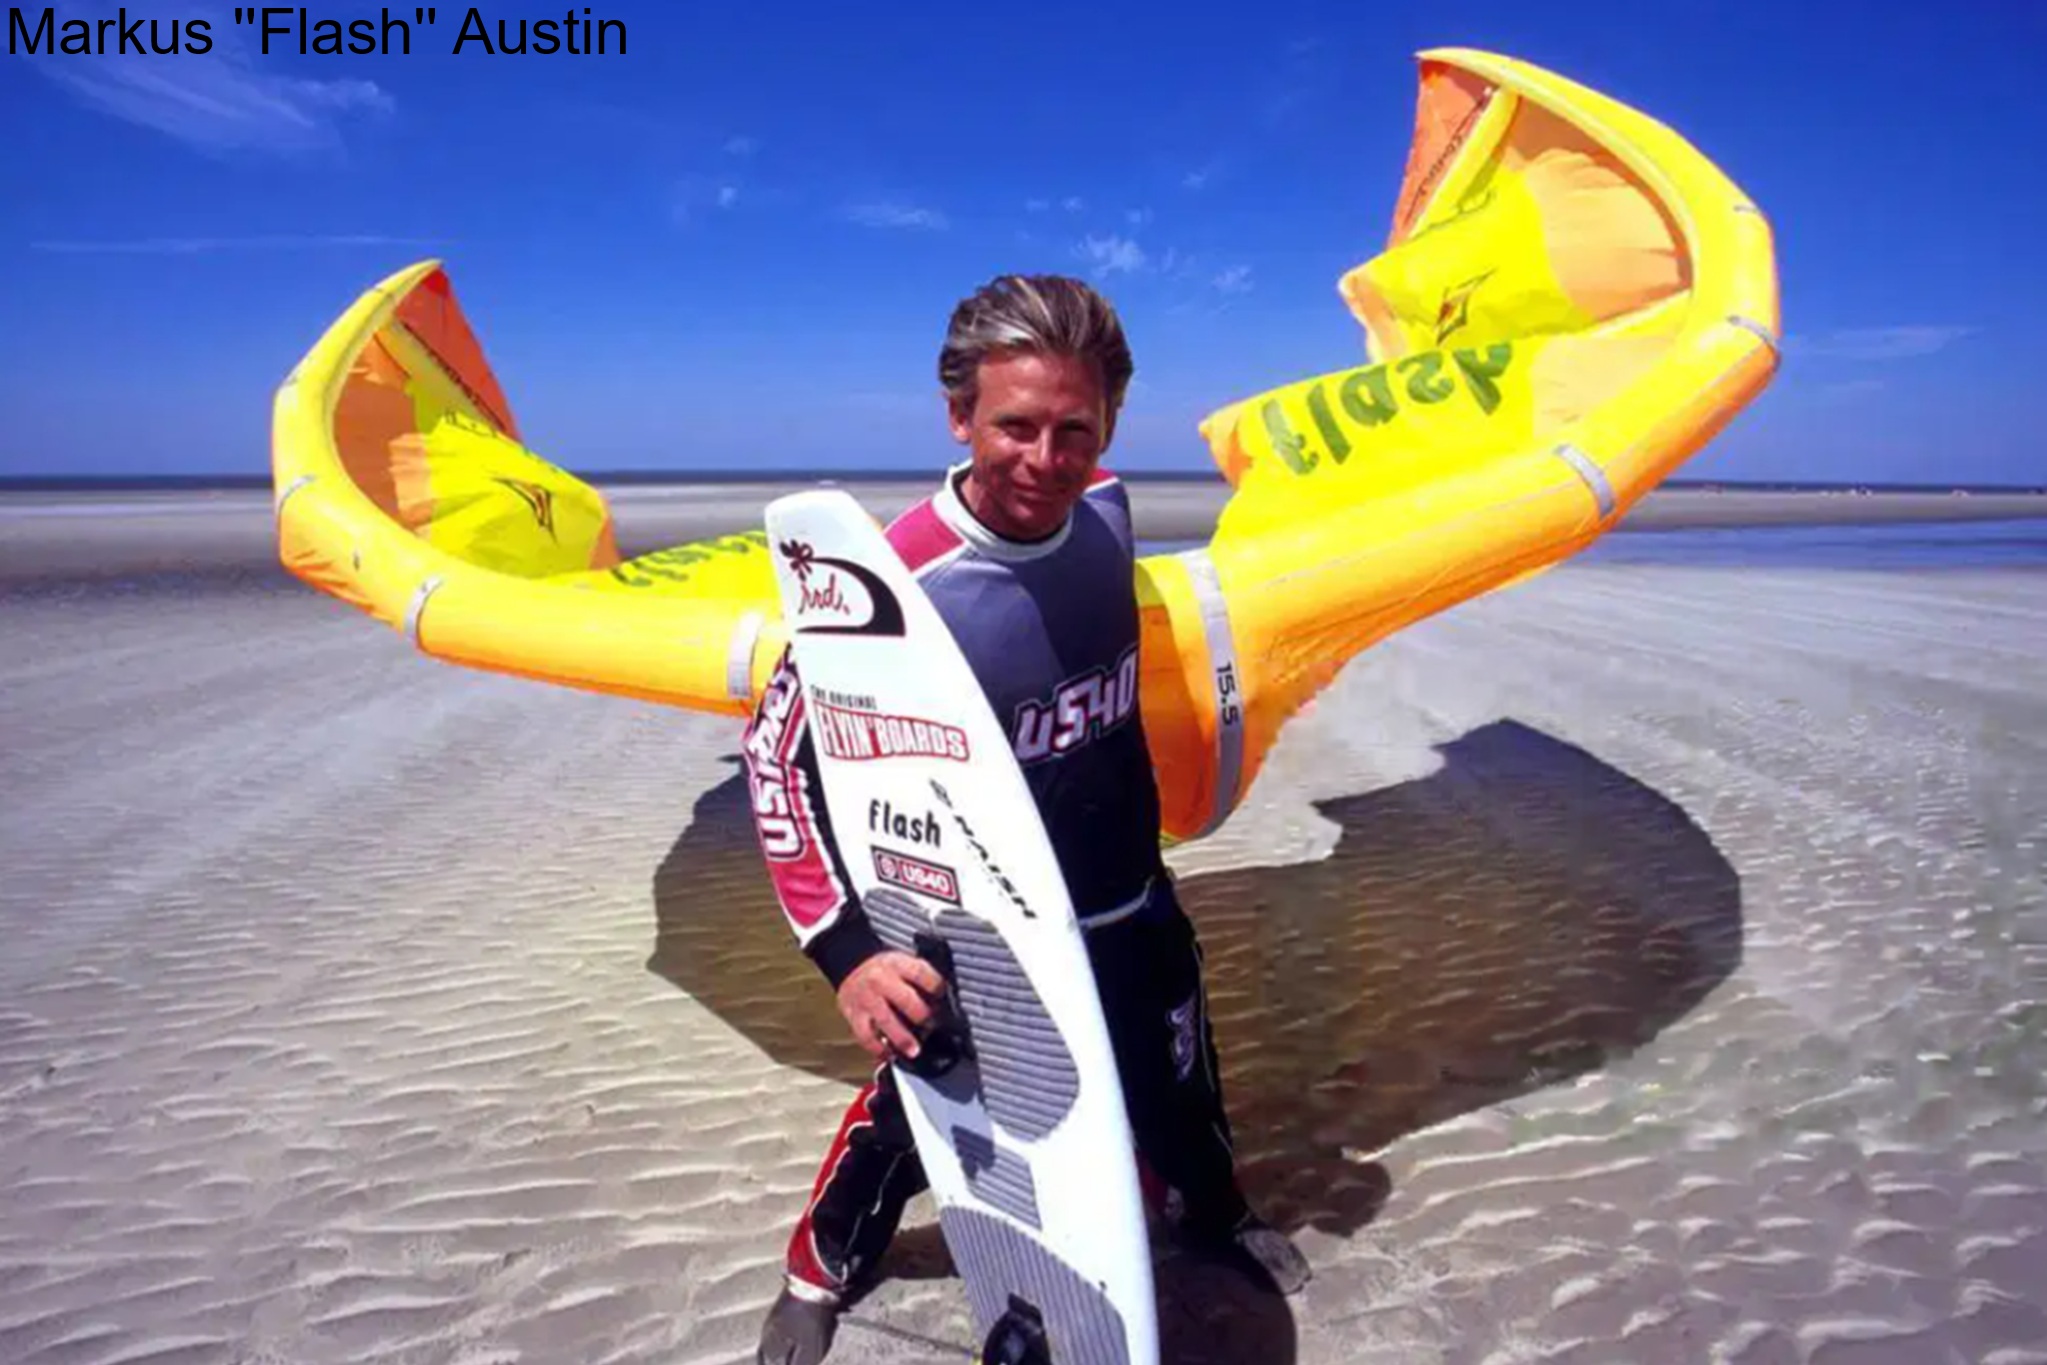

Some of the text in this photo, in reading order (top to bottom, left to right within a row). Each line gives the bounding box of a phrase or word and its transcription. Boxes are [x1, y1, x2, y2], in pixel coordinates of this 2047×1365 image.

[1216, 660, 1239, 726] 15.5
[869, 798, 941, 848] flash
[953, 814, 1037, 919] NAISH
